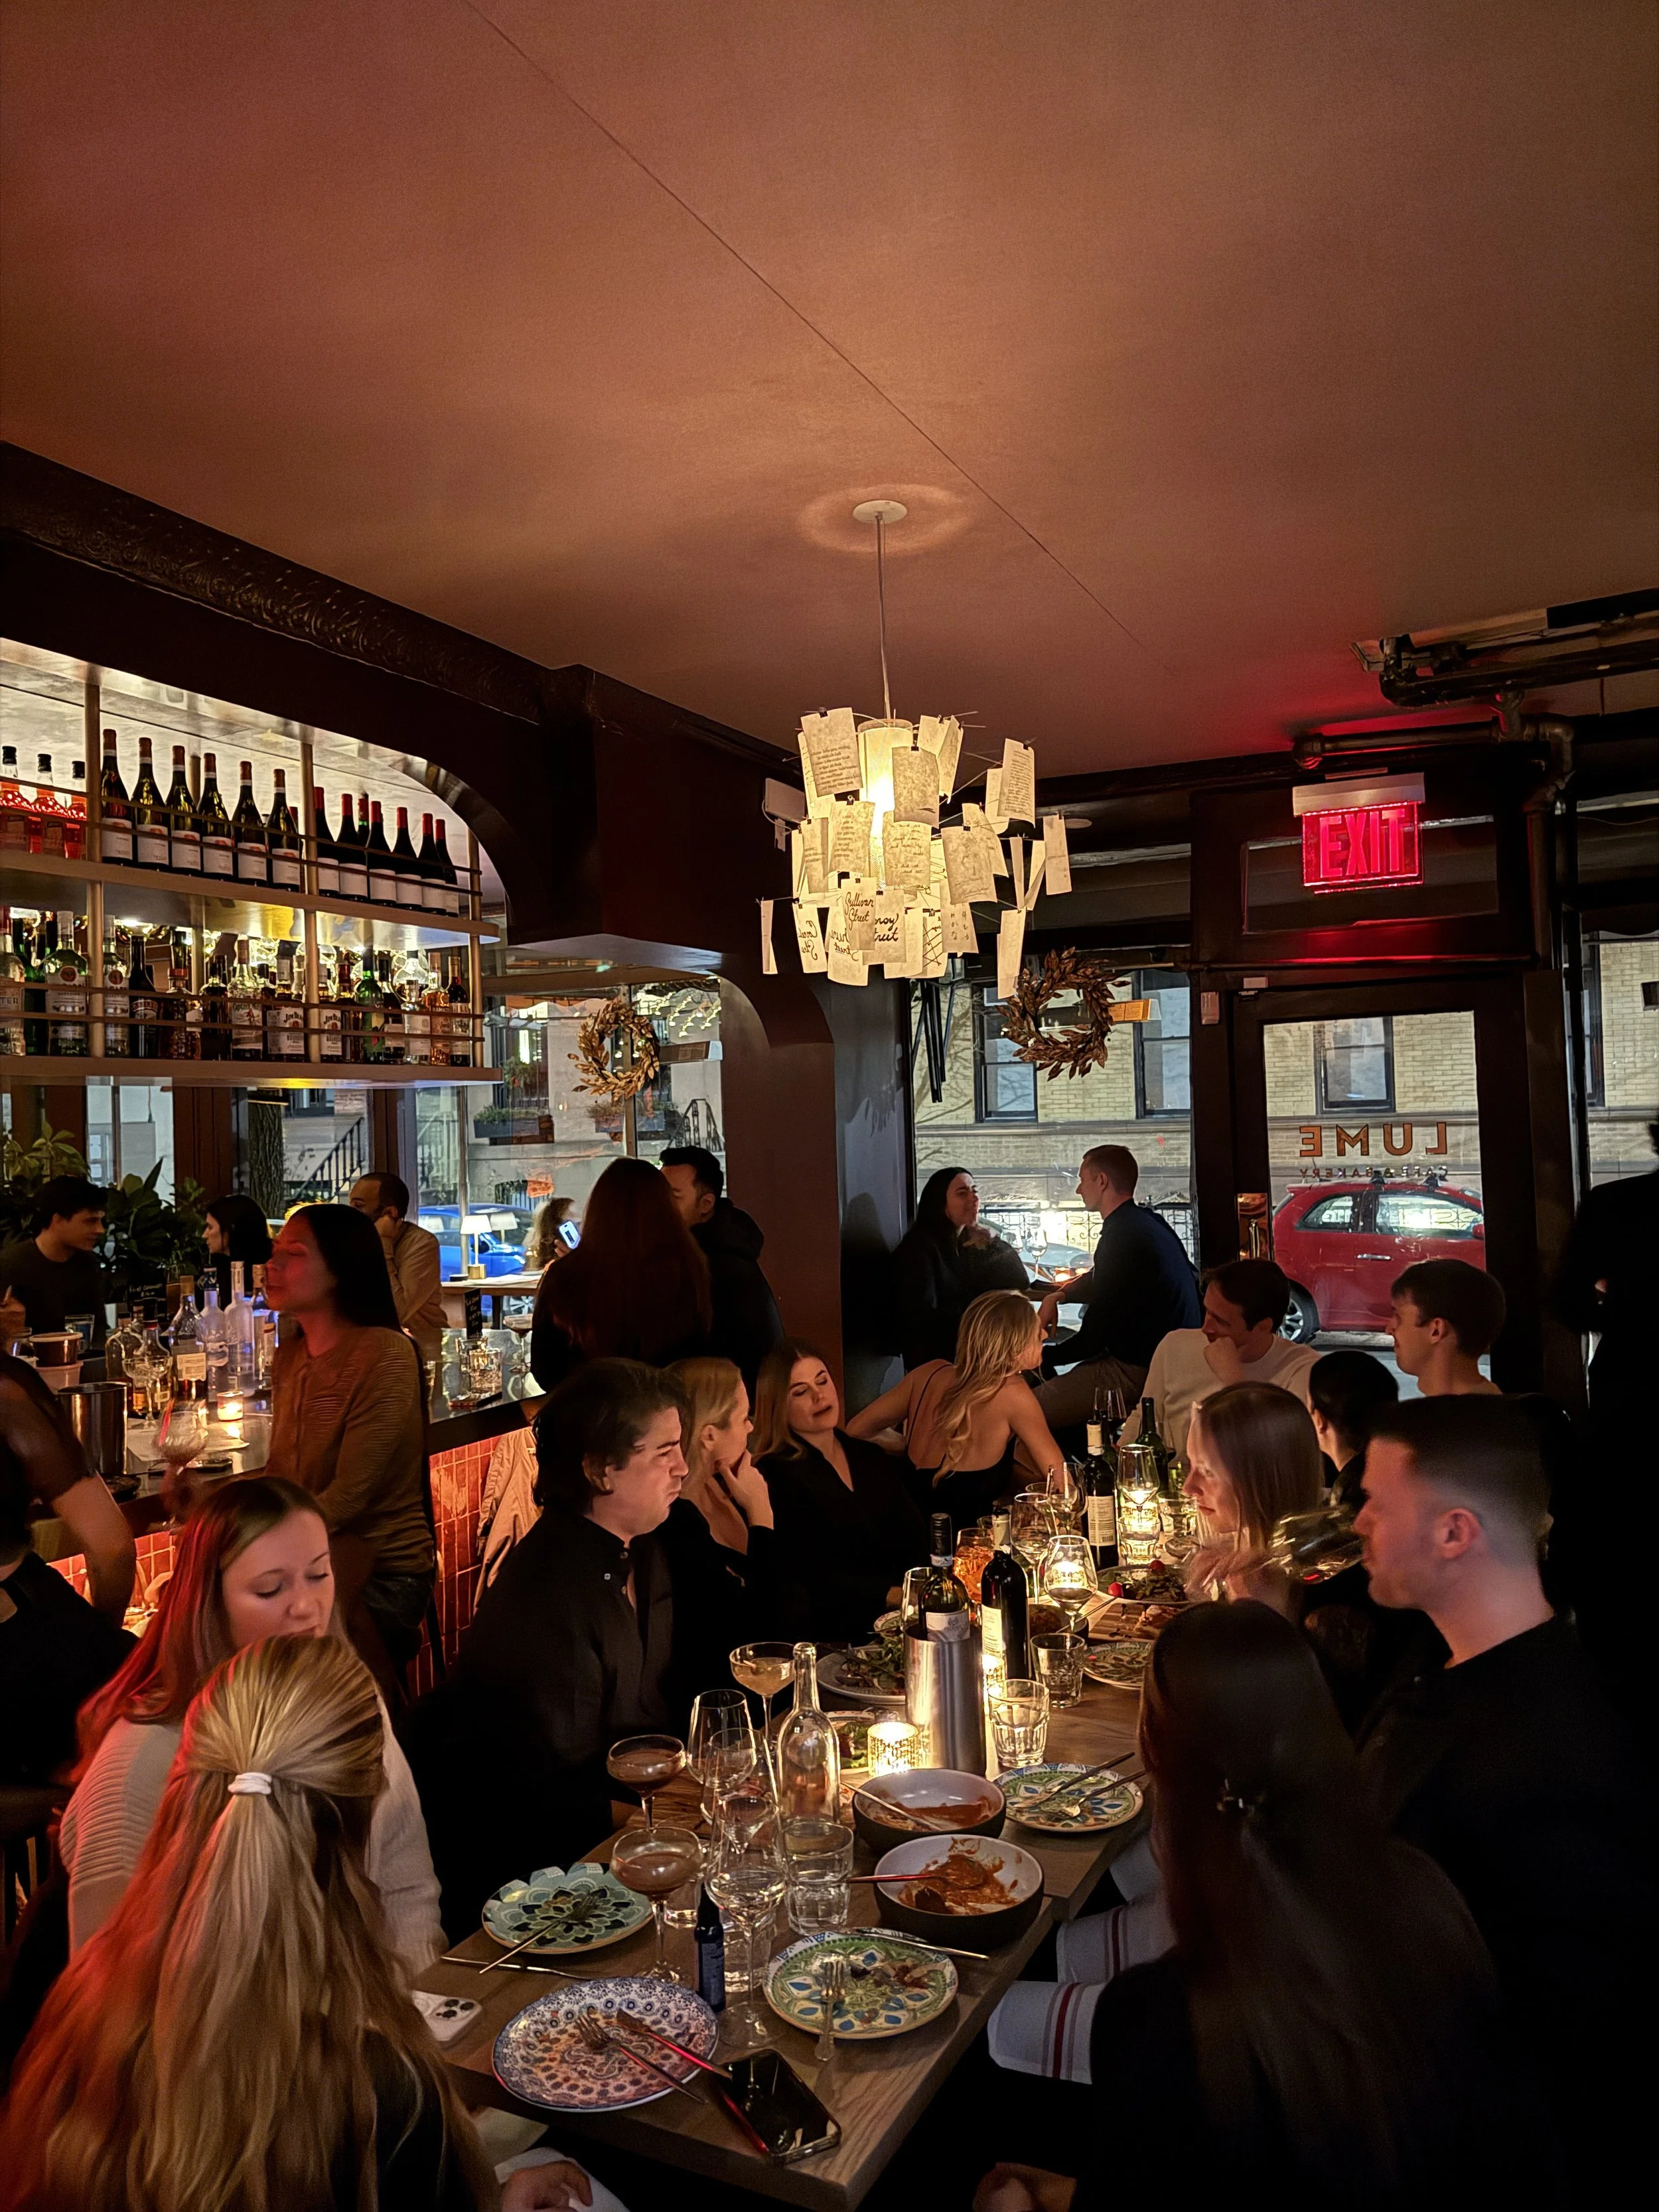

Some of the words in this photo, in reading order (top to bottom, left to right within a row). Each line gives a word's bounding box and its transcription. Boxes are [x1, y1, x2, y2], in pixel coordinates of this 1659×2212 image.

[1319, 808, 1406, 879] EXIT
[845, 891, 875, 916] Sullivan
[848, 907, 869, 931] Street
[874, 913, 899, 932] roy
[874, 926, 899, 942] treet
